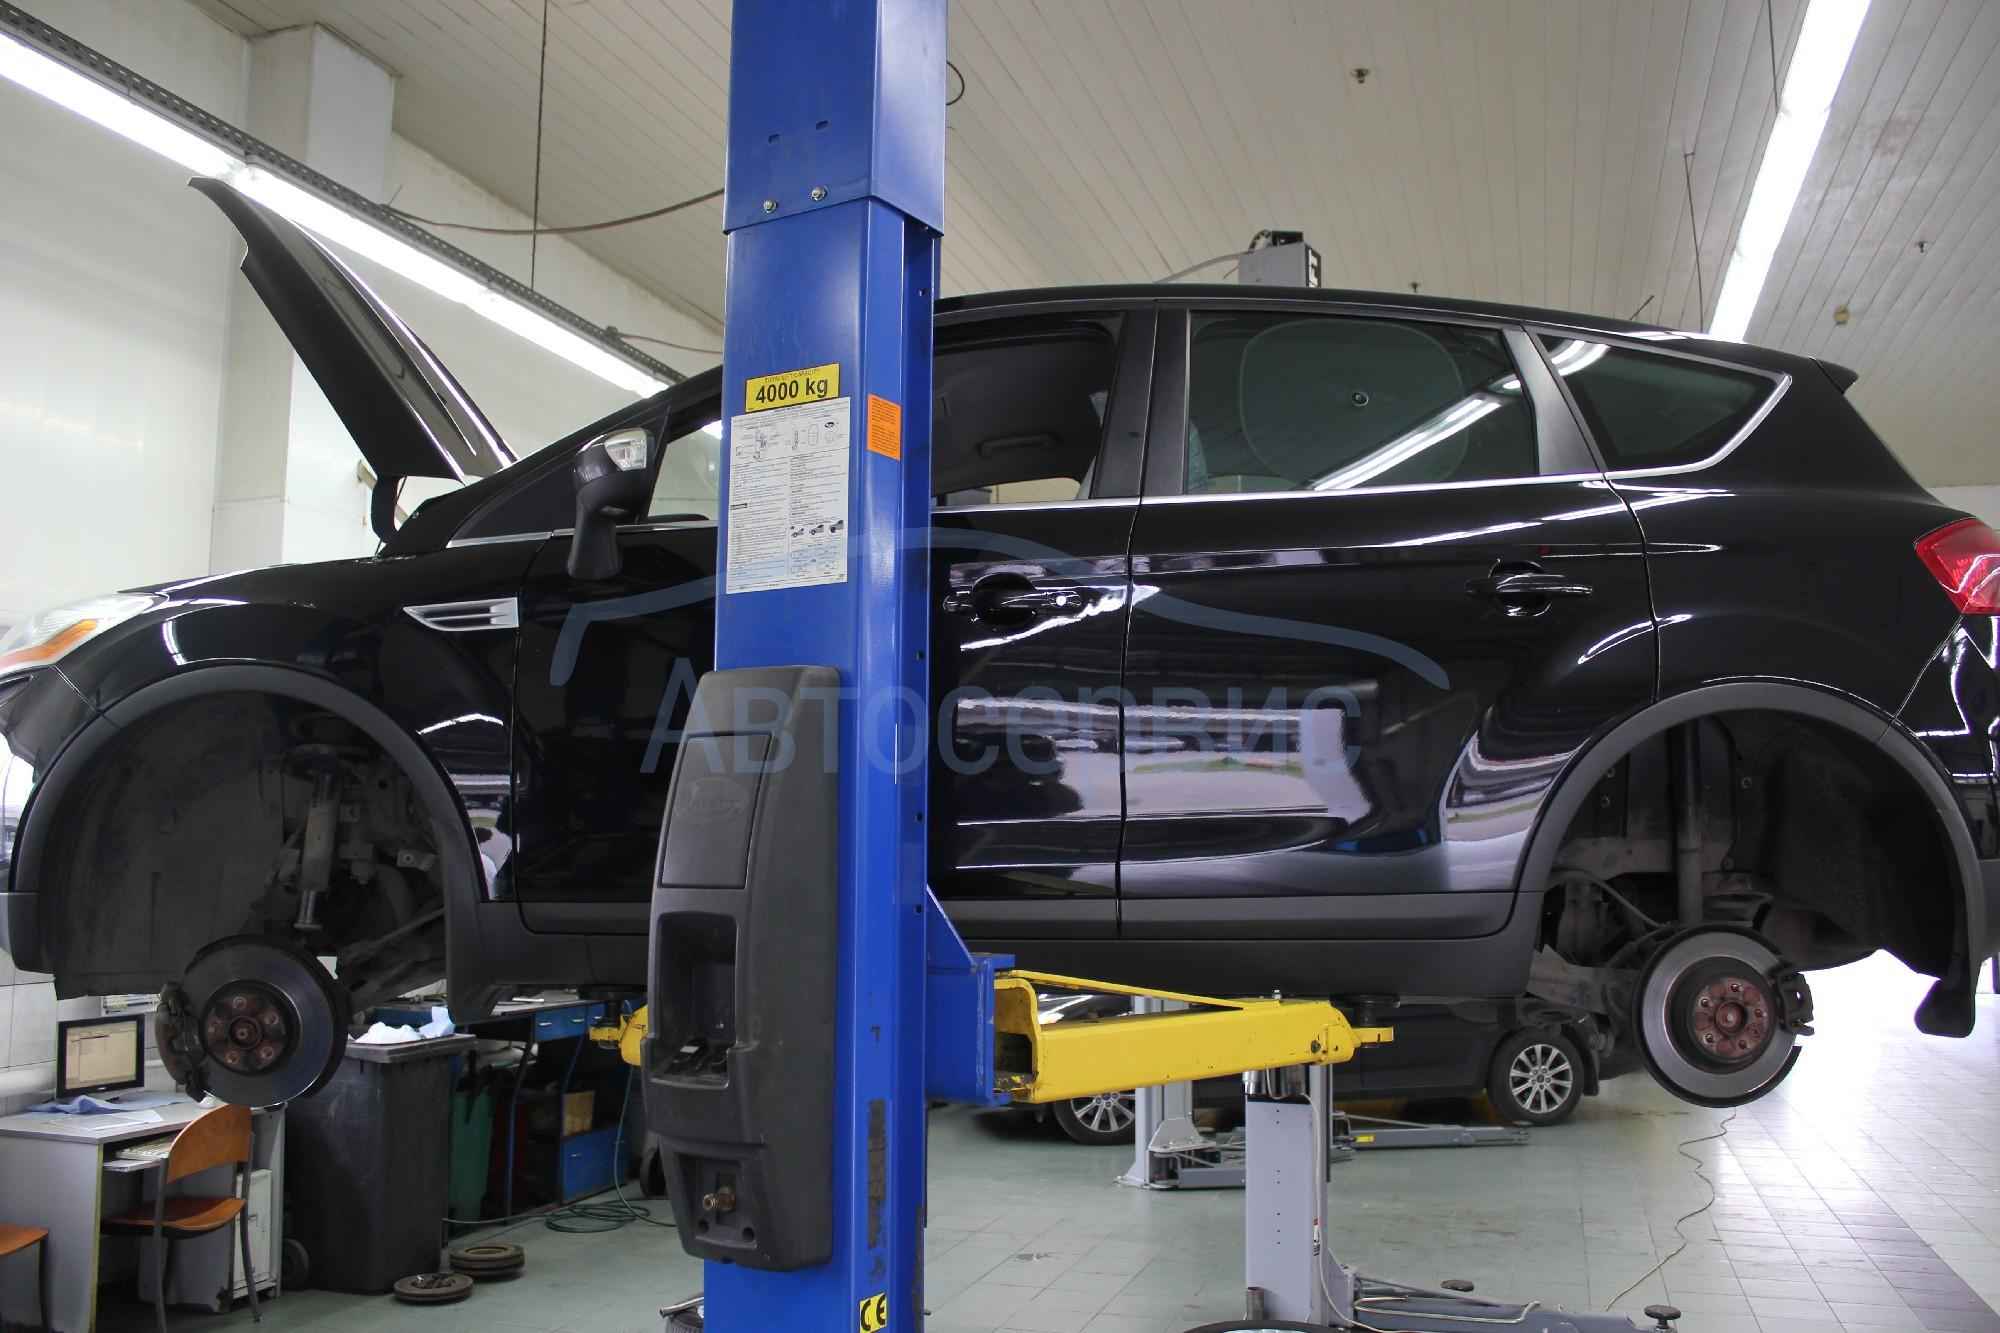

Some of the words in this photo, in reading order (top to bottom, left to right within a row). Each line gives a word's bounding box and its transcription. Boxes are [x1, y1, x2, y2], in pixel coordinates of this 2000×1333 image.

[756, 380, 799, 404] 4000
[806, 378, 828, 398] kg
[860, 1293, 886, 1331] CE
